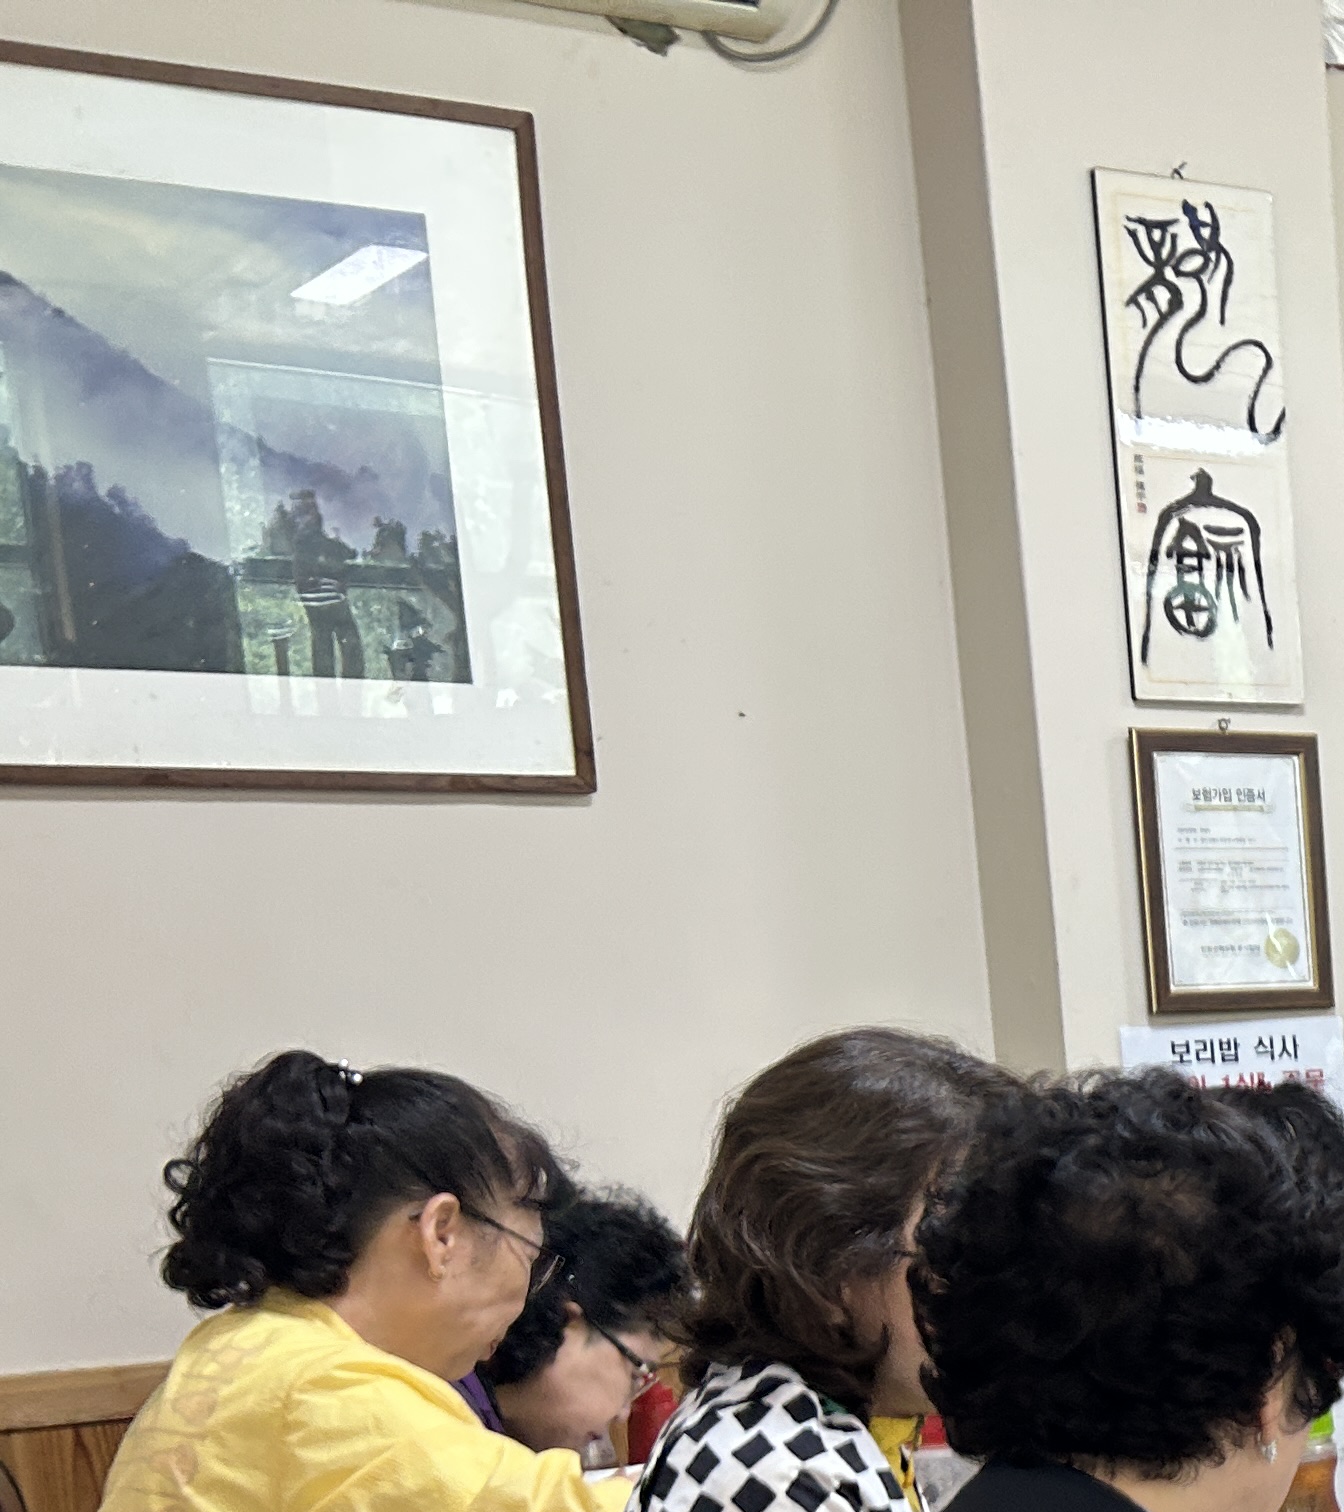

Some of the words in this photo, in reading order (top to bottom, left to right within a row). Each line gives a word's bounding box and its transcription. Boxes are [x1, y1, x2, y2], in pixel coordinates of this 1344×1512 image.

[1192, 787, 1232, 802] 보험가입
[1236, 787, 1265, 802] 인증서
[1170, 1036, 1240, 1064] 보리밥
[1254, 1034, 1299, 1061] 식사
